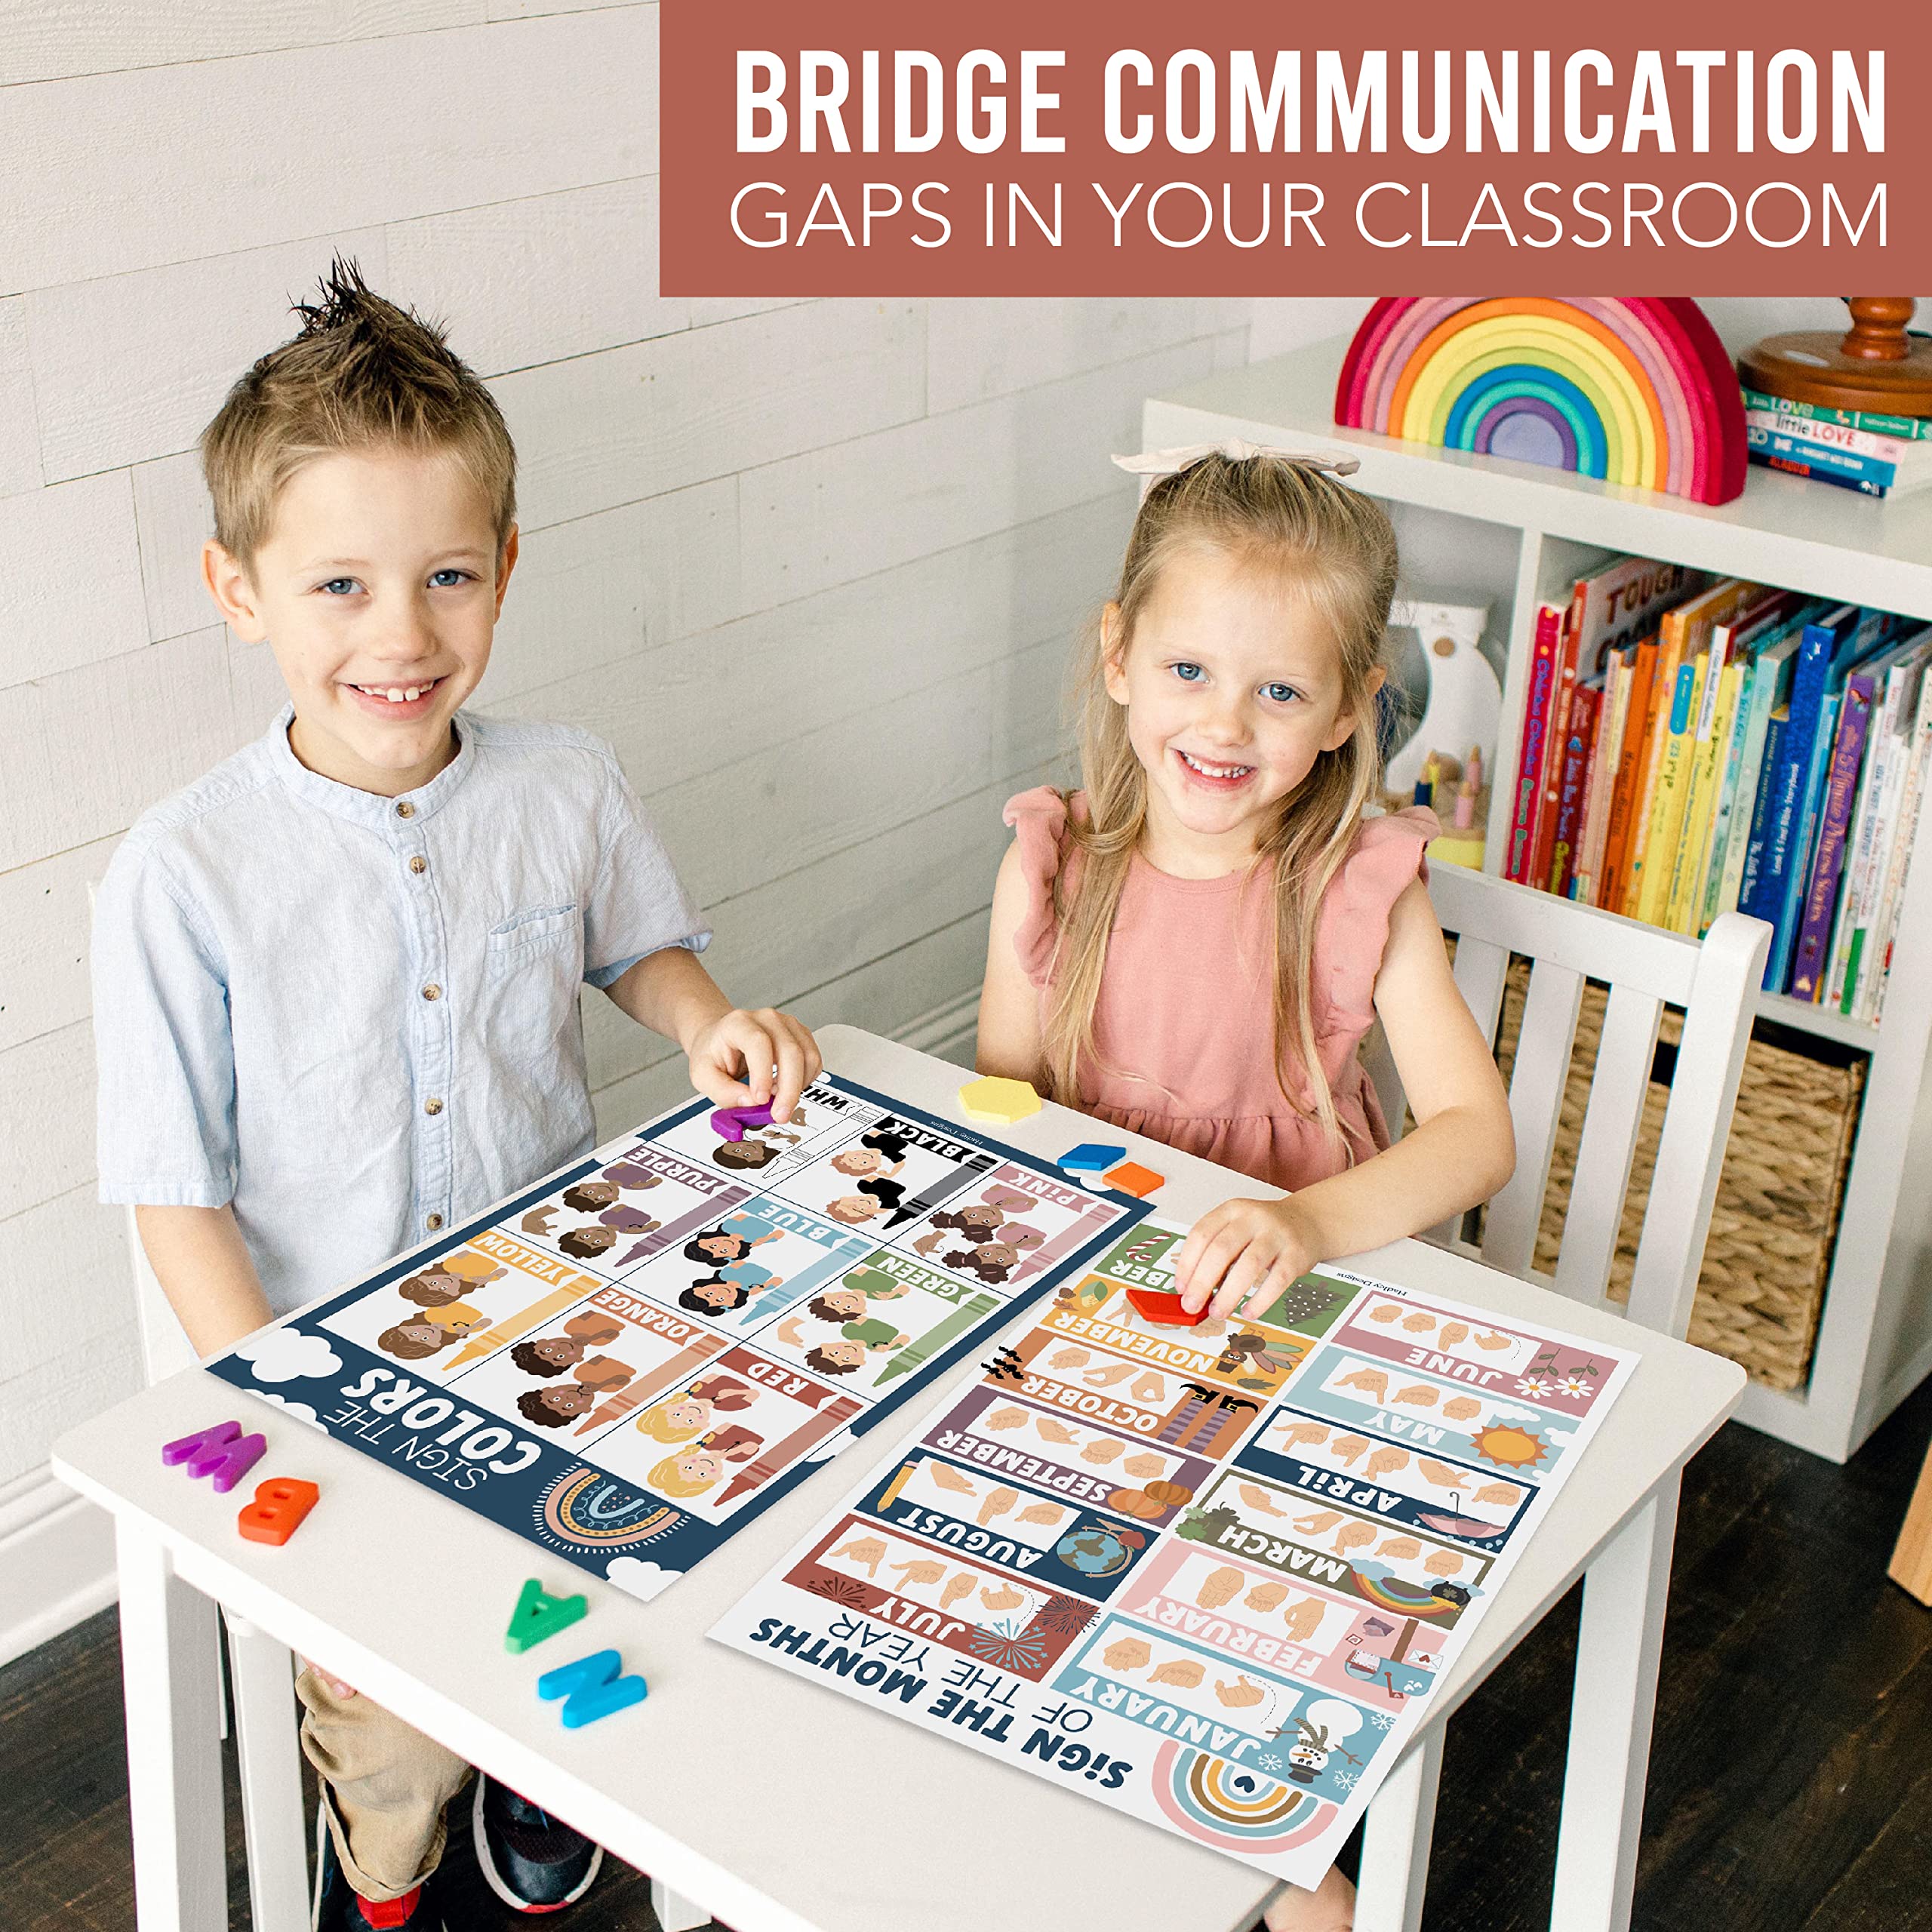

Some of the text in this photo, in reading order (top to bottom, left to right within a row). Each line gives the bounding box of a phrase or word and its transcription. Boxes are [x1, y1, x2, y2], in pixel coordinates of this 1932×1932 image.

[1776, 412, 1810, 435] little
[1811, 422, 1855, 447] LOVE
[884, 1120, 964, 1158] BLACK
[627, 1147, 718, 1191] PURPLE
[758, 1204, 825, 1241] BLUE
[473, 1235, 565, 1279] YELLOW
[875, 1255, 961, 1297] GREEN
[1337, 1272, 1408, 1296] Hadley Designs
[593, 1289, 692, 1338] ORANGE
[1054, 1311, 1216, 1374] NOVEMBER
[1404, 1346, 1503, 1386] JUNE
[745, 1364, 809, 1395] RED
[1020, 1375, 1158, 1432] OCTOBER
[322, 1400, 488, 1491] SIGN THE
[340, 1367, 543, 1475] COLORS
[1362, 1411, 1447, 1446] MAY
[936, 1429, 1112, 1502] SEPTEMBER
[896, 1508, 1044, 1570] AUGUST
[1217, 1524, 1349, 1583] MARCH
[868, 1595, 967, 1641] JULY
[1133, 1595, 1323, 1678] FEBRUARY
[749, 1617, 929, 1705] MONTHS
[828, 1612, 1094, 1734] OF THE YEAR
[927, 1688, 1016, 1743] THE
[1069, 1675, 1263, 1761] JANUARY
